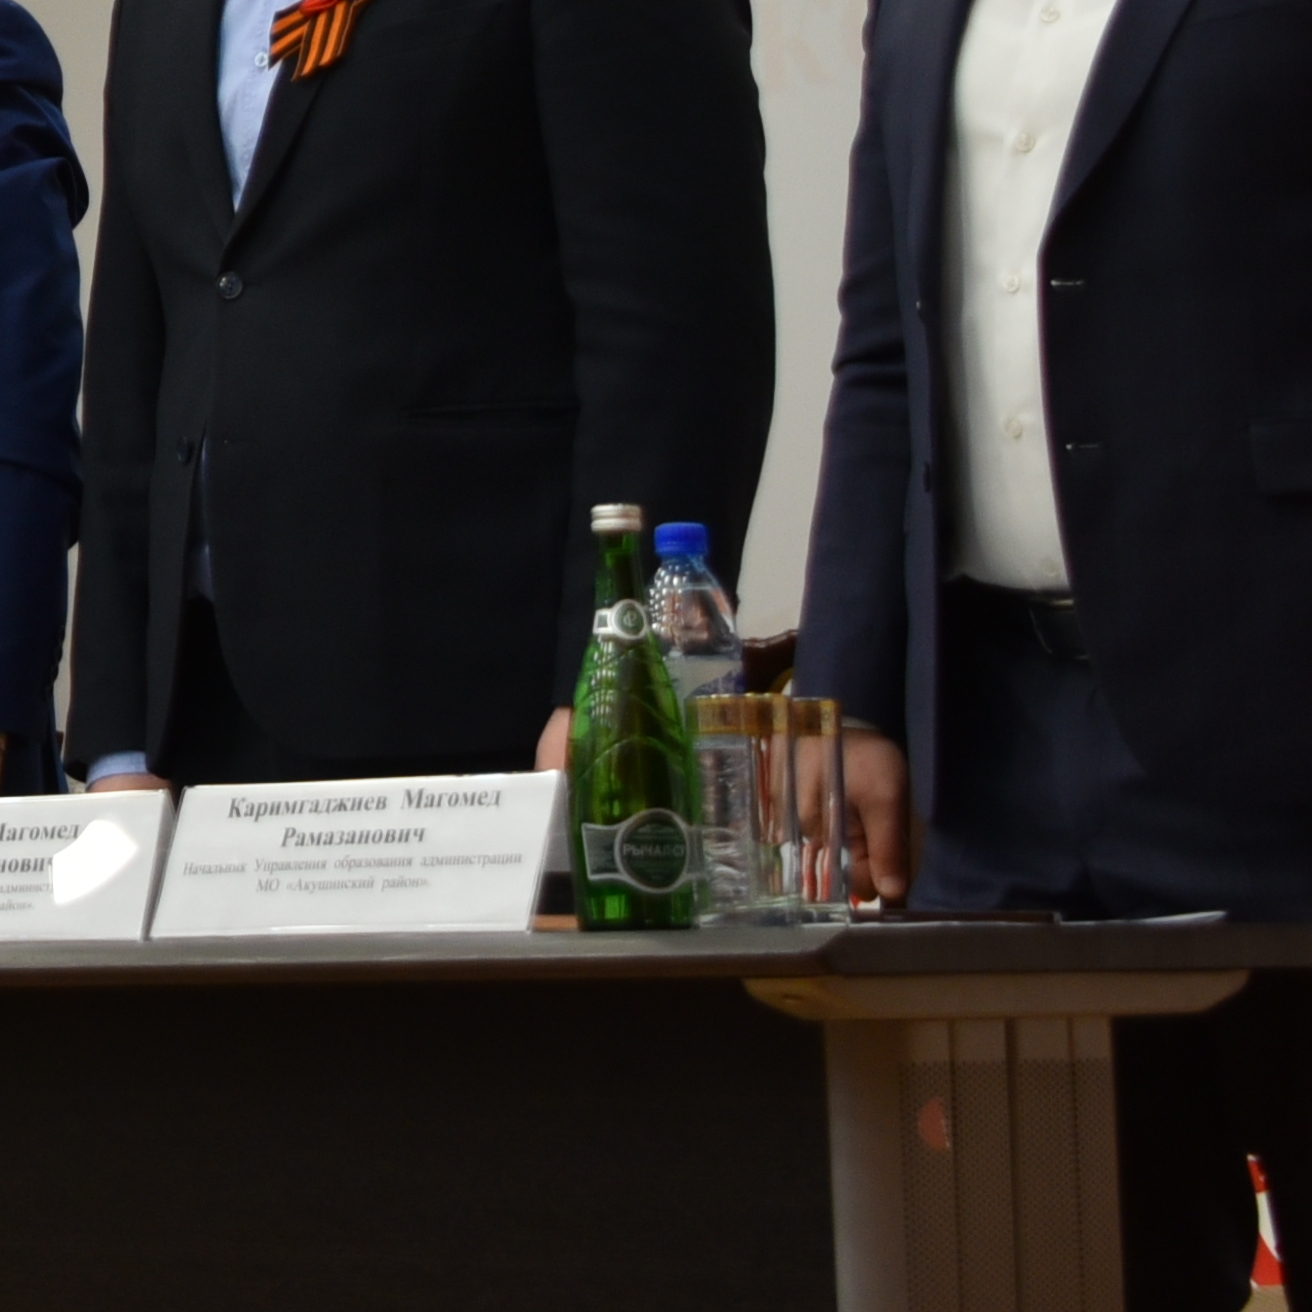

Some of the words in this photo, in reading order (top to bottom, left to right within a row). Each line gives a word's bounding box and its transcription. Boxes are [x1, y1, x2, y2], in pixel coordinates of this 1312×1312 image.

[228, 795, 388, 822] Каримгаджиев
[399, 788, 502, 811] Магомед
[280, 826, 426, 848] Рамазанович
[182, 860, 247, 877] Начальник
[253, 856, 328, 876] Управления
[333, 853, 413, 871] образования
[419, 850, 523, 868] администрации
[256, 878, 281, 893] МО
